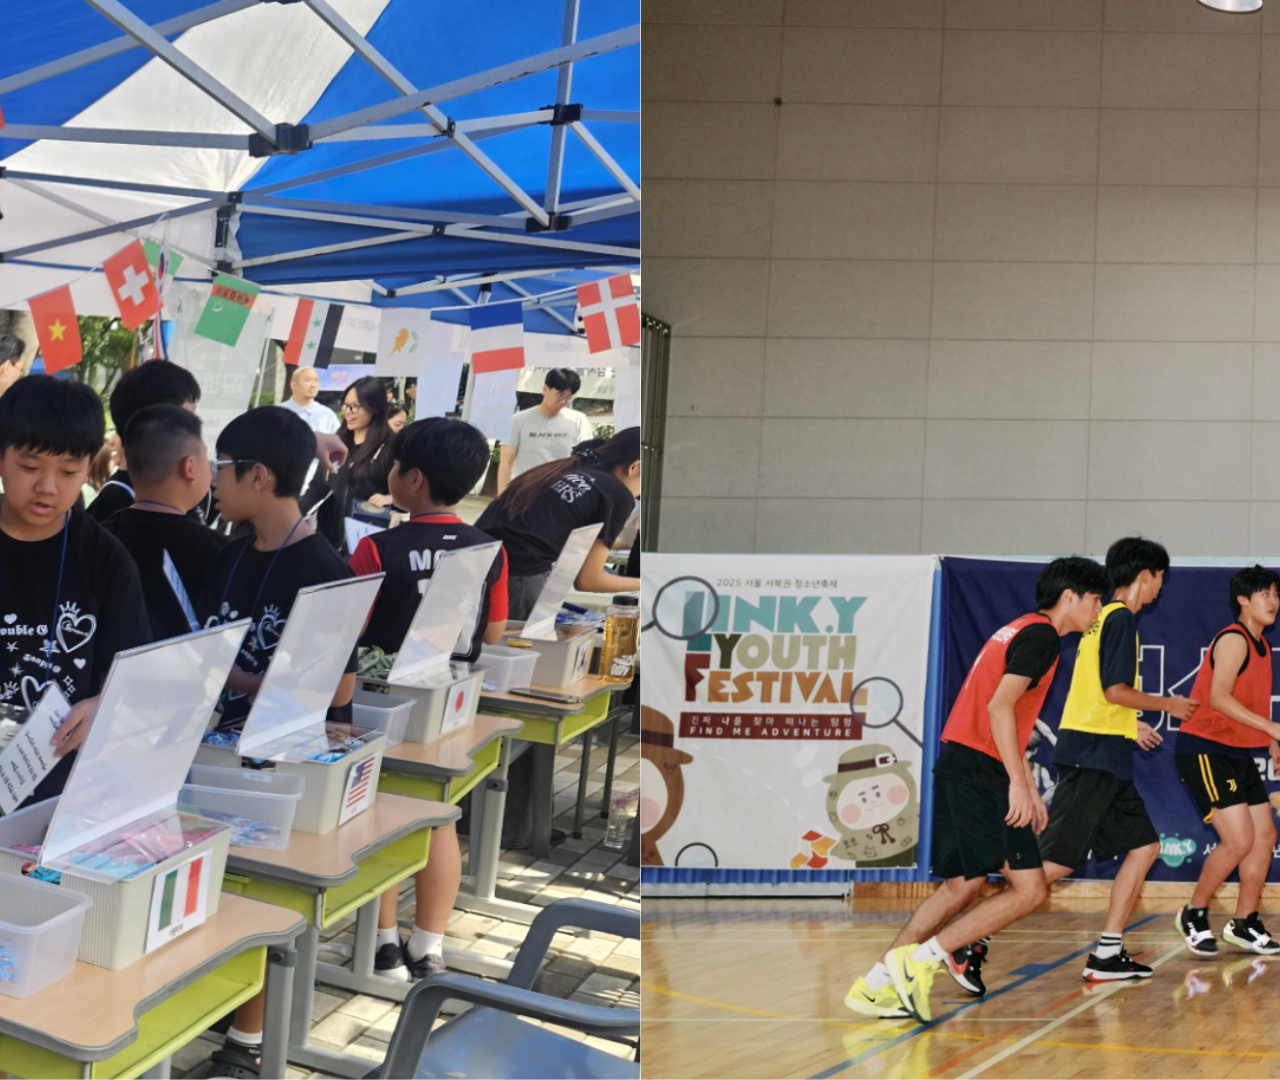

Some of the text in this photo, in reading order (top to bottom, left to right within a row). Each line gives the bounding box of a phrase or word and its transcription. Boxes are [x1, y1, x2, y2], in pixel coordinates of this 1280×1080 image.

[717, 578, 742, 587] 2025
[745, 578, 762, 588] 서울
[794, 579, 838, 589] 청소년축제
[713, 633, 858, 671] YOUTH
[684, 653, 869, 706] FESTIVAL
[690, 726, 852, 737] FIND ME ADVENTURE
